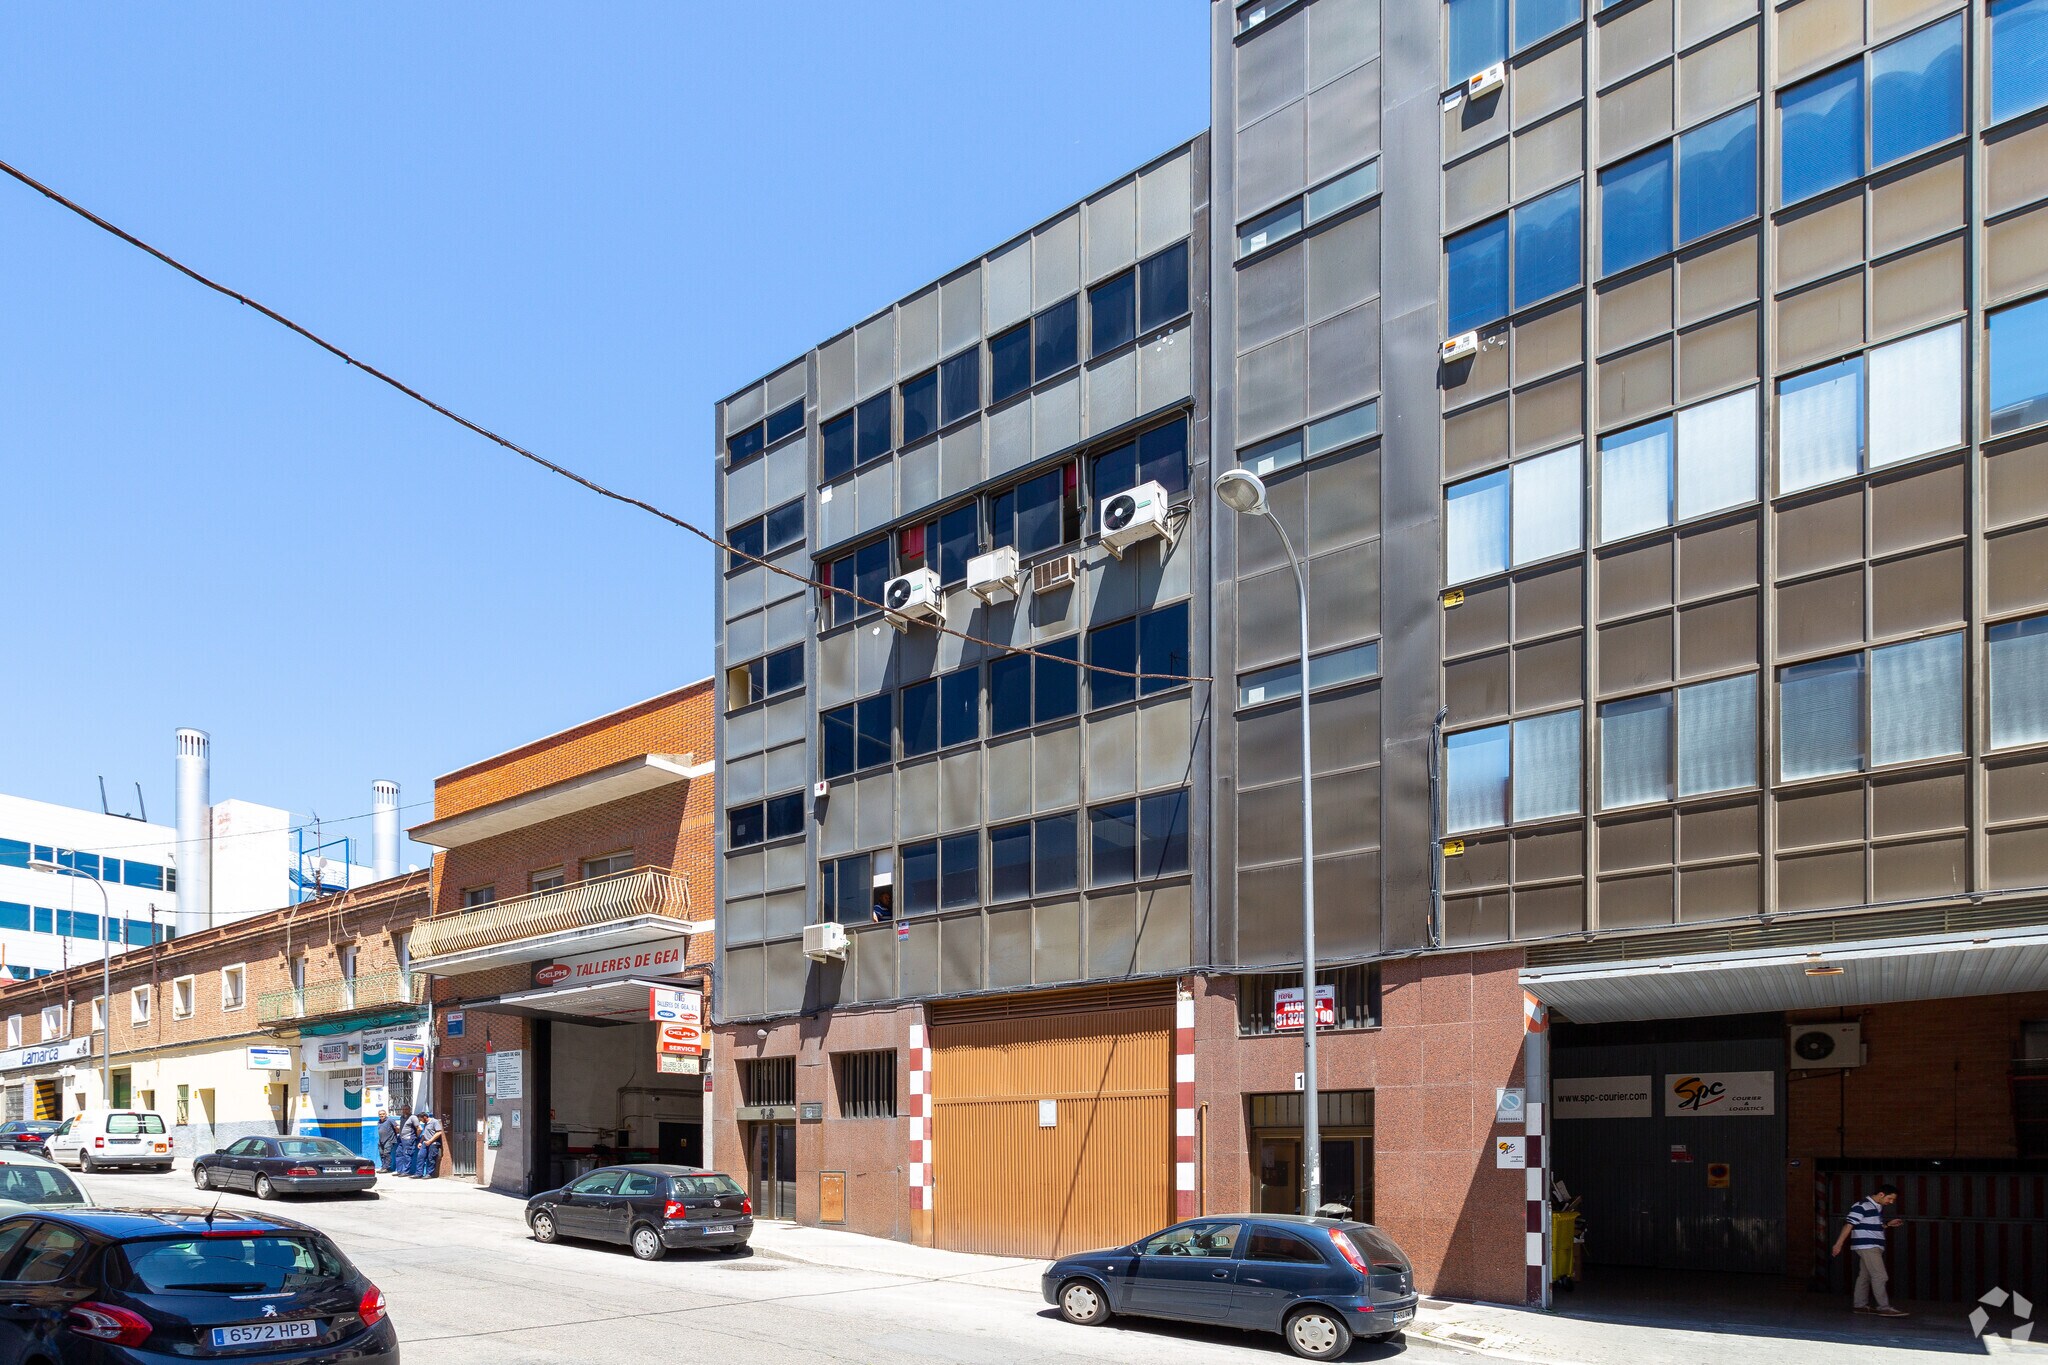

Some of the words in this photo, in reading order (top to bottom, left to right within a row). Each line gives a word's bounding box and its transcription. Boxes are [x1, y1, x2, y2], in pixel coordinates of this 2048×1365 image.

[576, 956, 631, 977] TALLERES
[634, 953, 651, 967] DE
[653, 949, 679, 965] GEA
[540, 970, 567, 979] DELPHI
[656, 1000, 674, 1008] TALLERES
[667, 1029, 697, 1037] DELPHI
[363, 1042, 383, 1051] Bendix
[21, 1047, 59, 1066] Lamarca
[344, 1079, 362, 1087] Bendix
[1558, 1092, 1648, 1104] www.spc-courier.com
[1674, 1077, 1726, 1111] Spc
[230, 1326, 275, 1343] 6572
[279, 1323, 311, 1338] HPB
